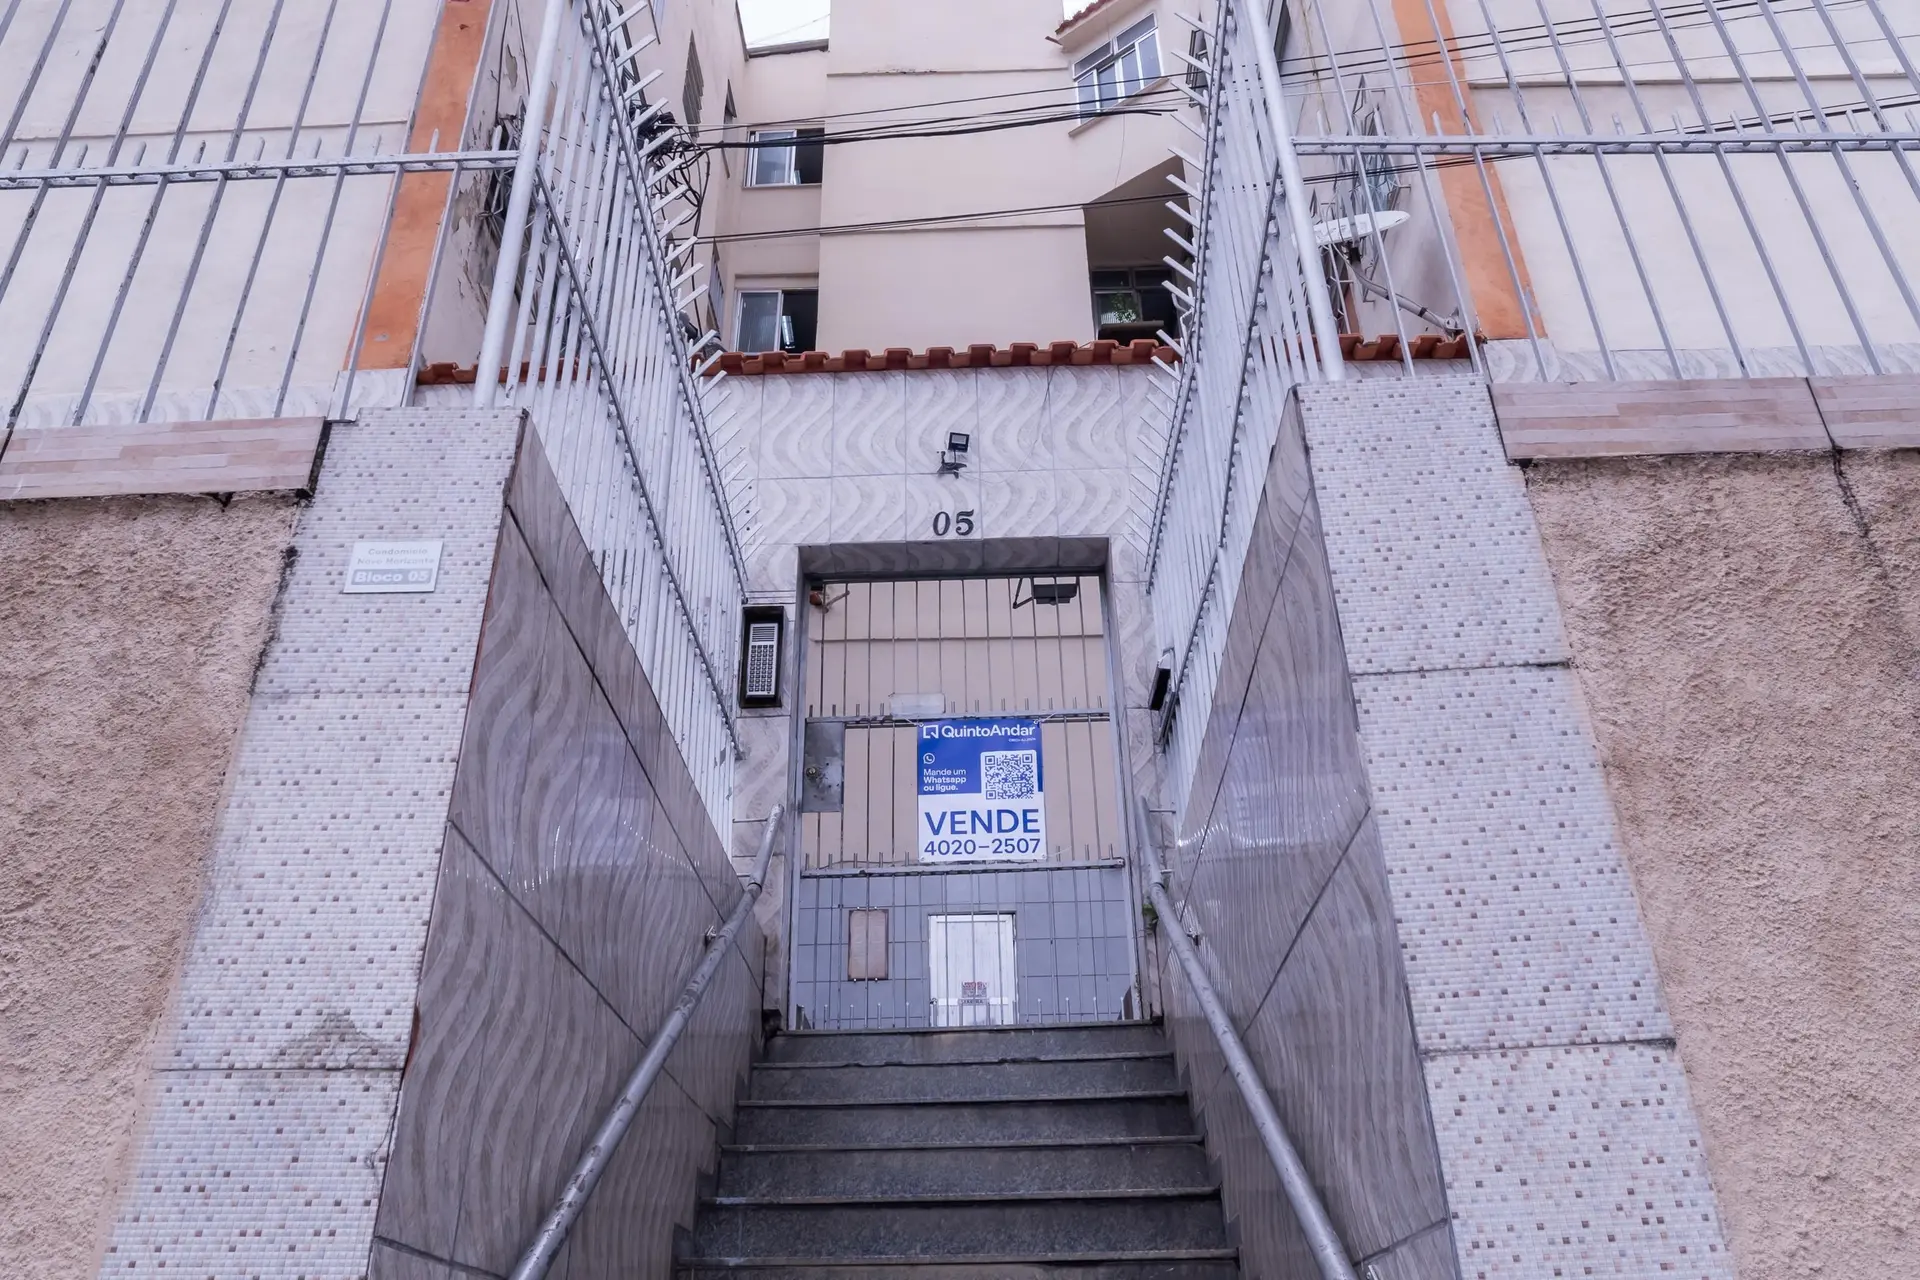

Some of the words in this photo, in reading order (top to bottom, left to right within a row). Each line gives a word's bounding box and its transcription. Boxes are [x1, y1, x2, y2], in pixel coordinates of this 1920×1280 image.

[933, 509, 974, 536] 05
[354, 571, 403, 583] Bloco
[408, 570, 429, 582] 05
[941, 724, 1036, 738] QuintoAndar
[923, 776, 967, 785] Whatsapp
[935, 784, 959, 793] ligue.
[924, 808, 1040, 836] VENDE
[924, 838, 1041, 856] 4020-2507
